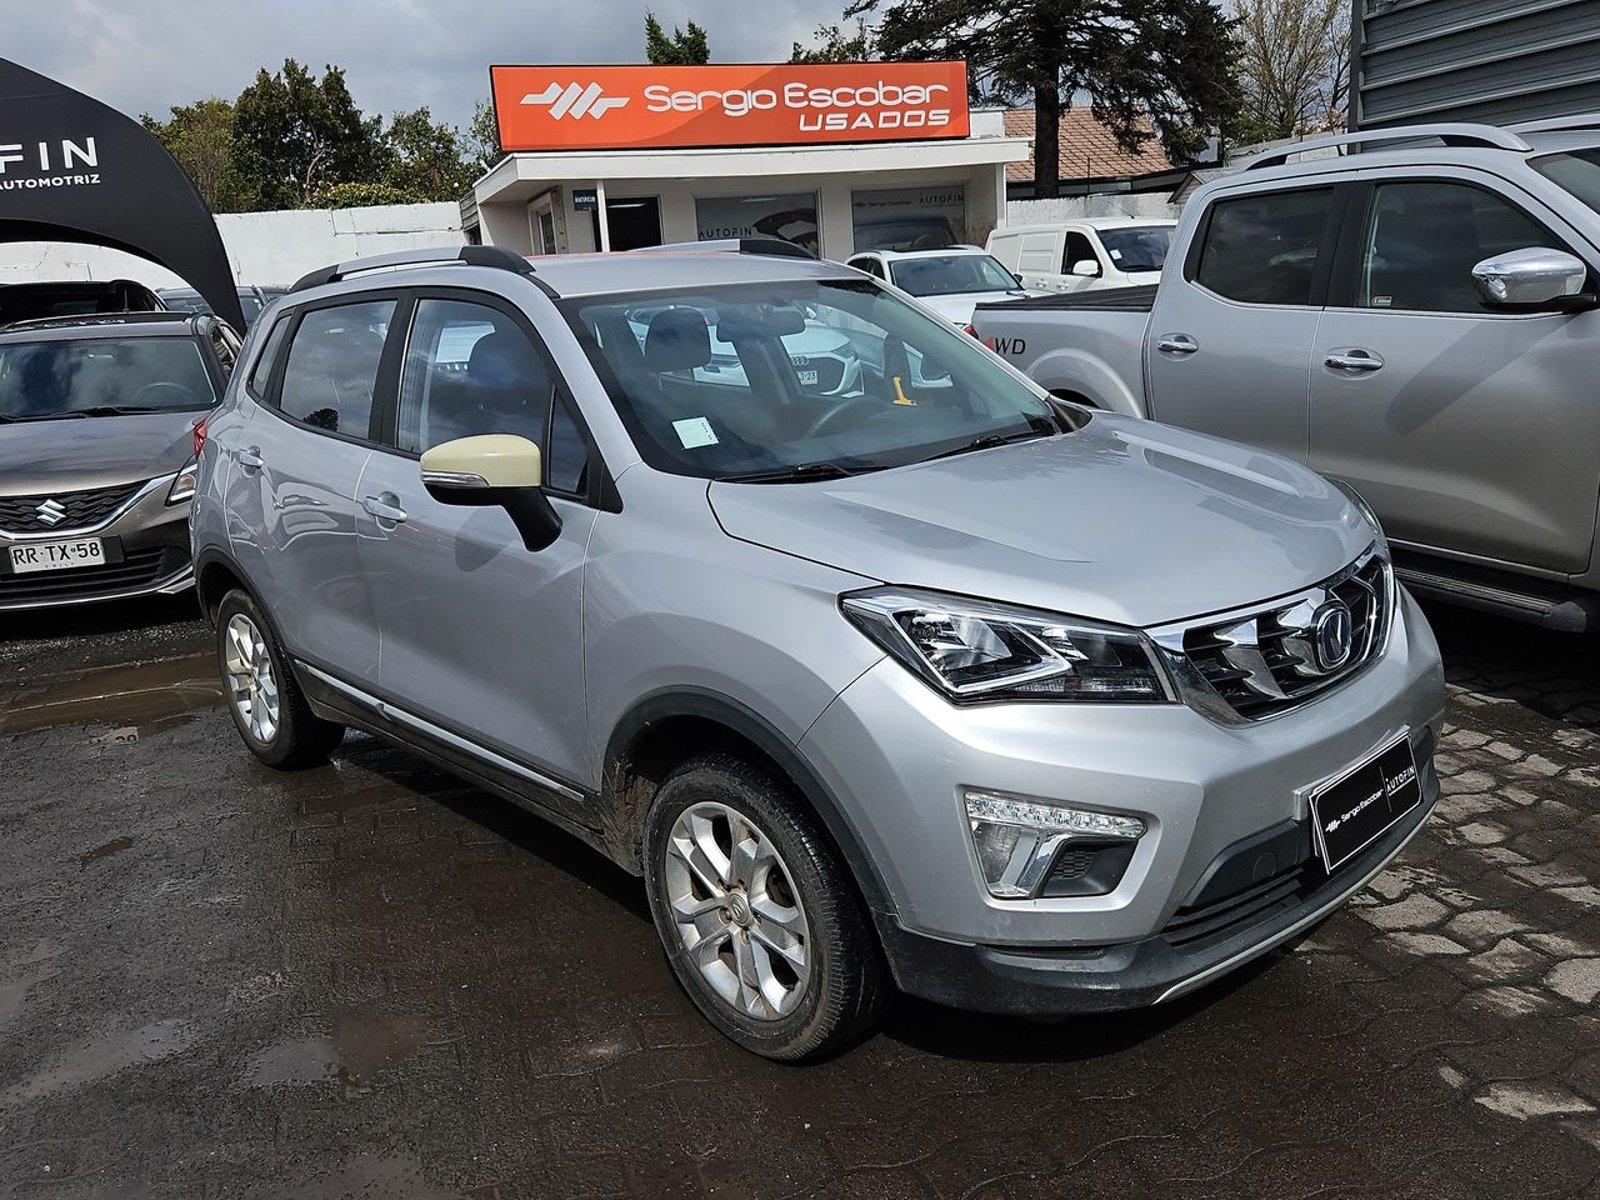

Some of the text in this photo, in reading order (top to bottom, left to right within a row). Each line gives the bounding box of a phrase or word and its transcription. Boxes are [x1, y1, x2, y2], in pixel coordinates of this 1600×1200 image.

[643, 81, 949, 117] Sergio Escobar
[799, 109, 951, 132] USADOS
[698, 226, 752, 240] AUTOFIN
